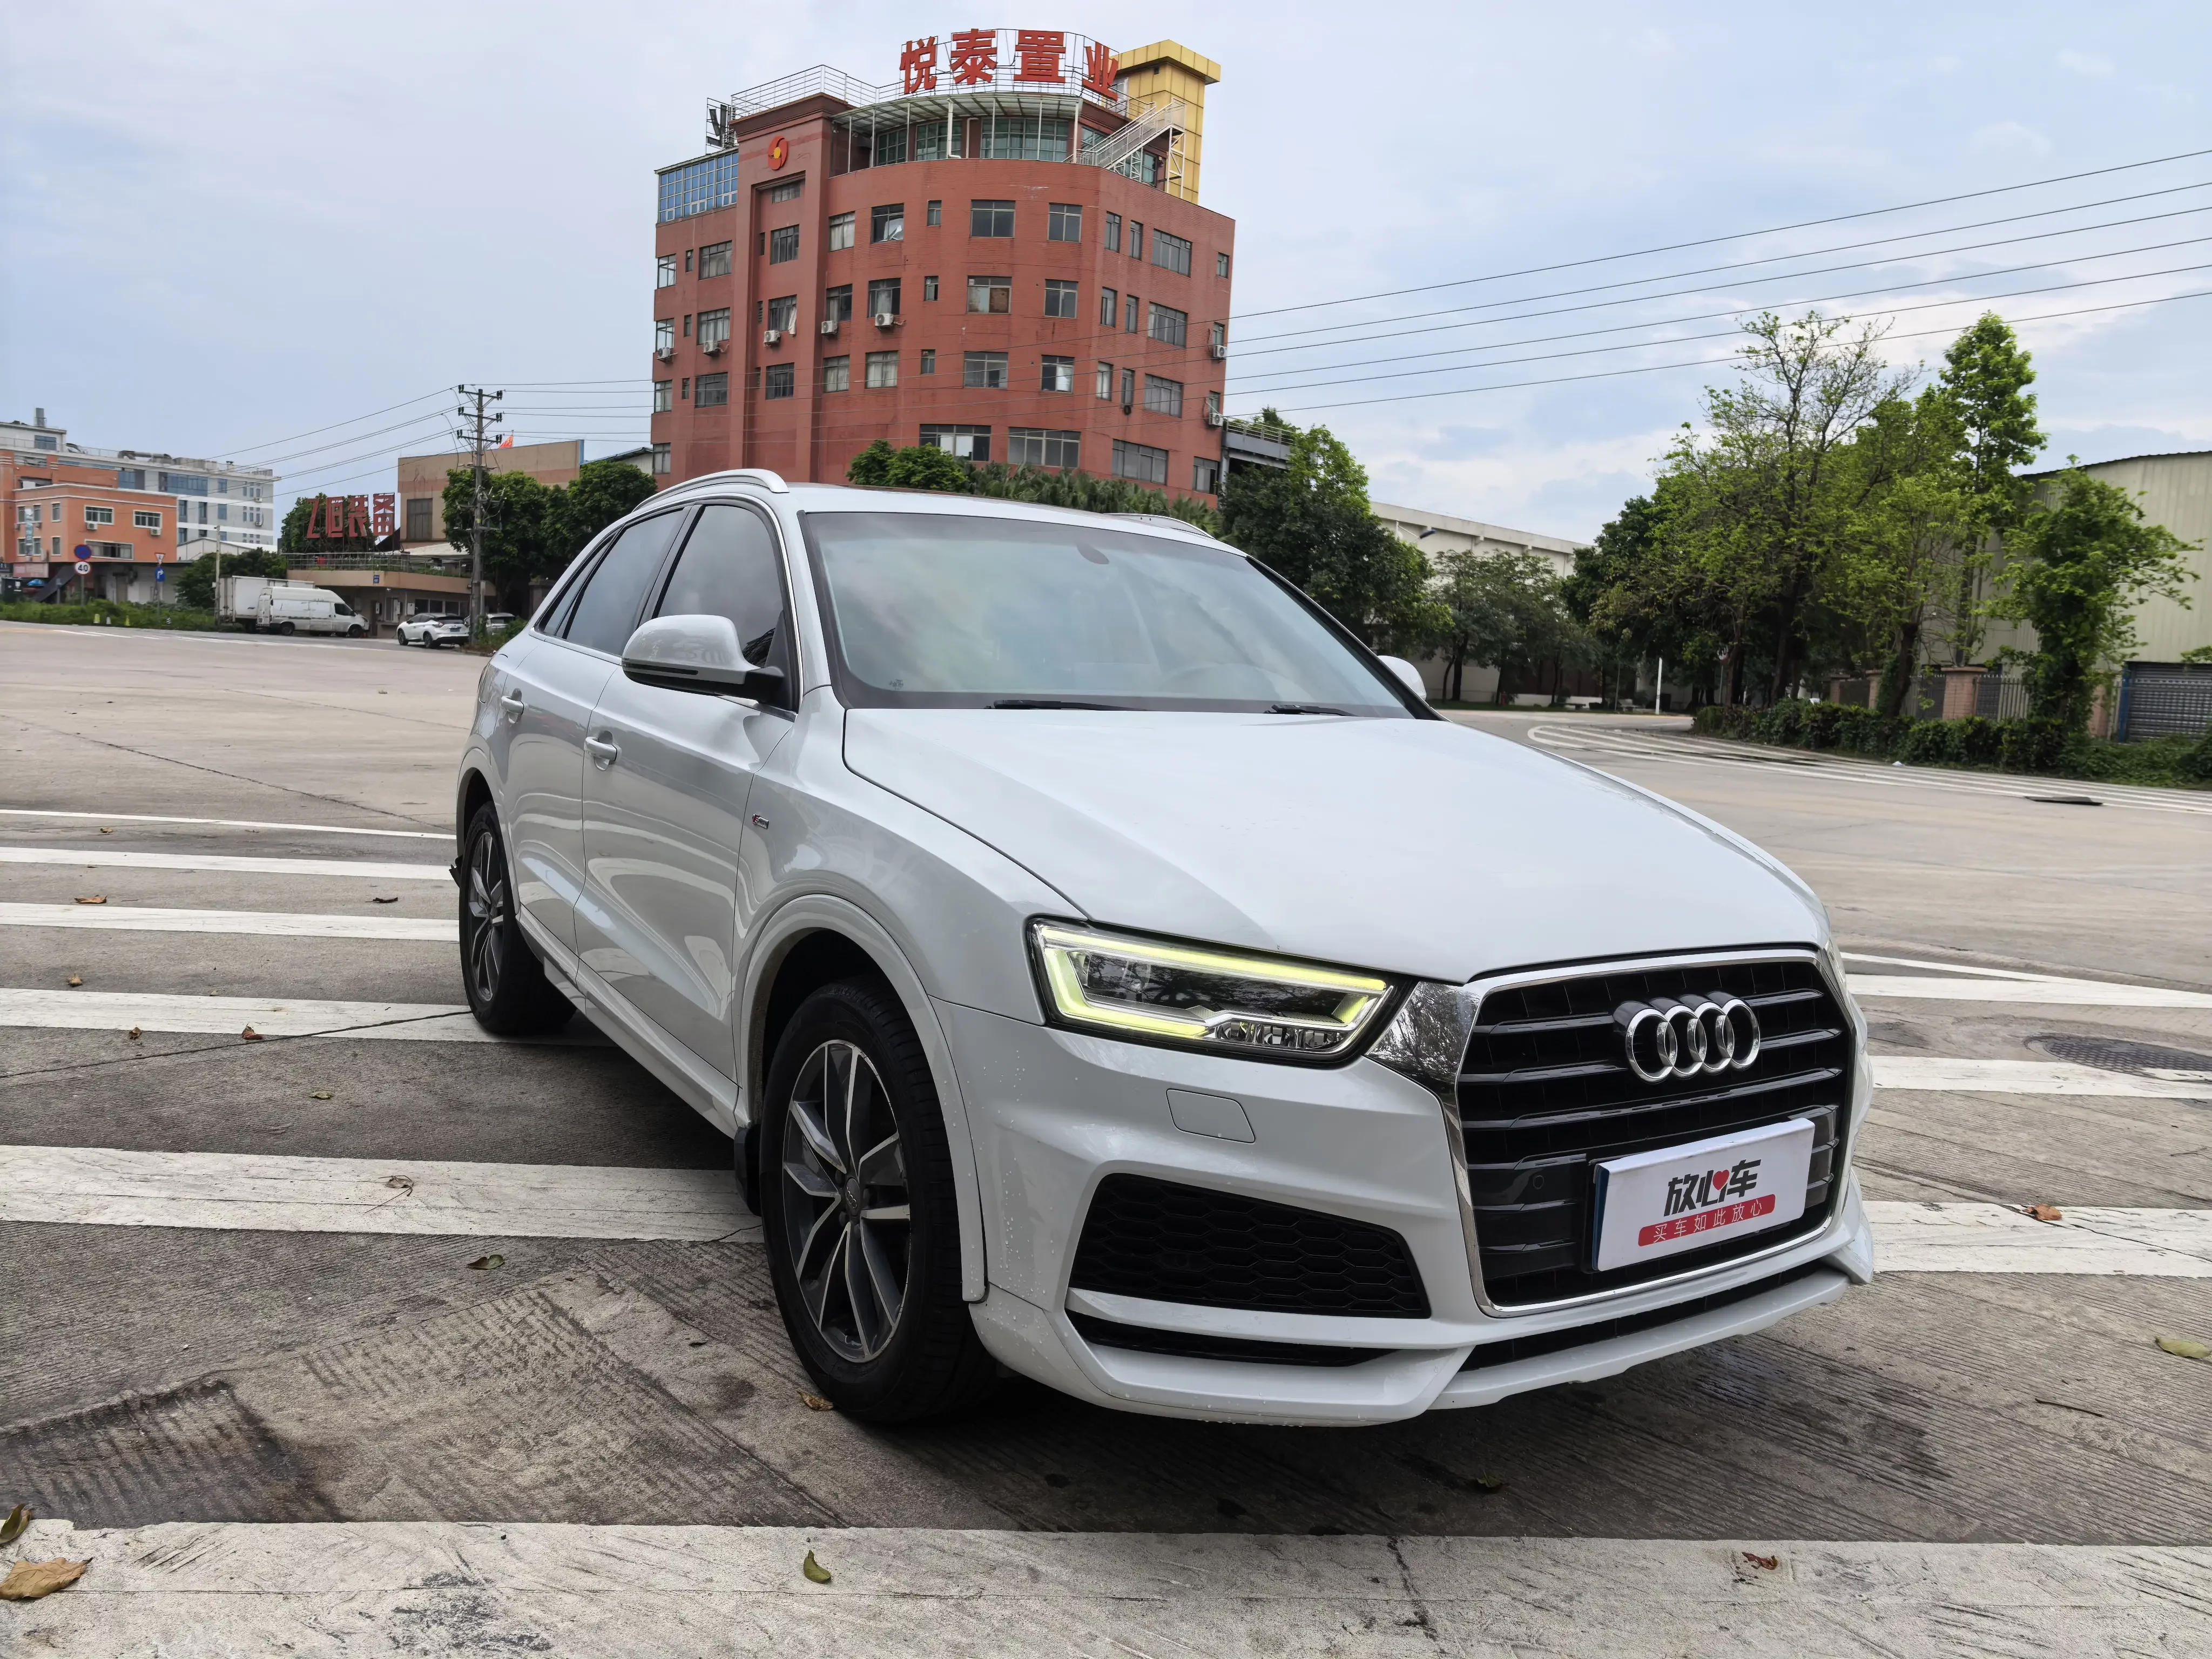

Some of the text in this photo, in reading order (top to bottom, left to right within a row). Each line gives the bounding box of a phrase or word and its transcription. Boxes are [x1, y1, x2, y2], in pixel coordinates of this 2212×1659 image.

[900, 29, 1118, 100] 悦泰置业
[1664, 1159, 1762, 1217] 放心车
[1653, 1199, 1762, 1243] 买车如此放心
